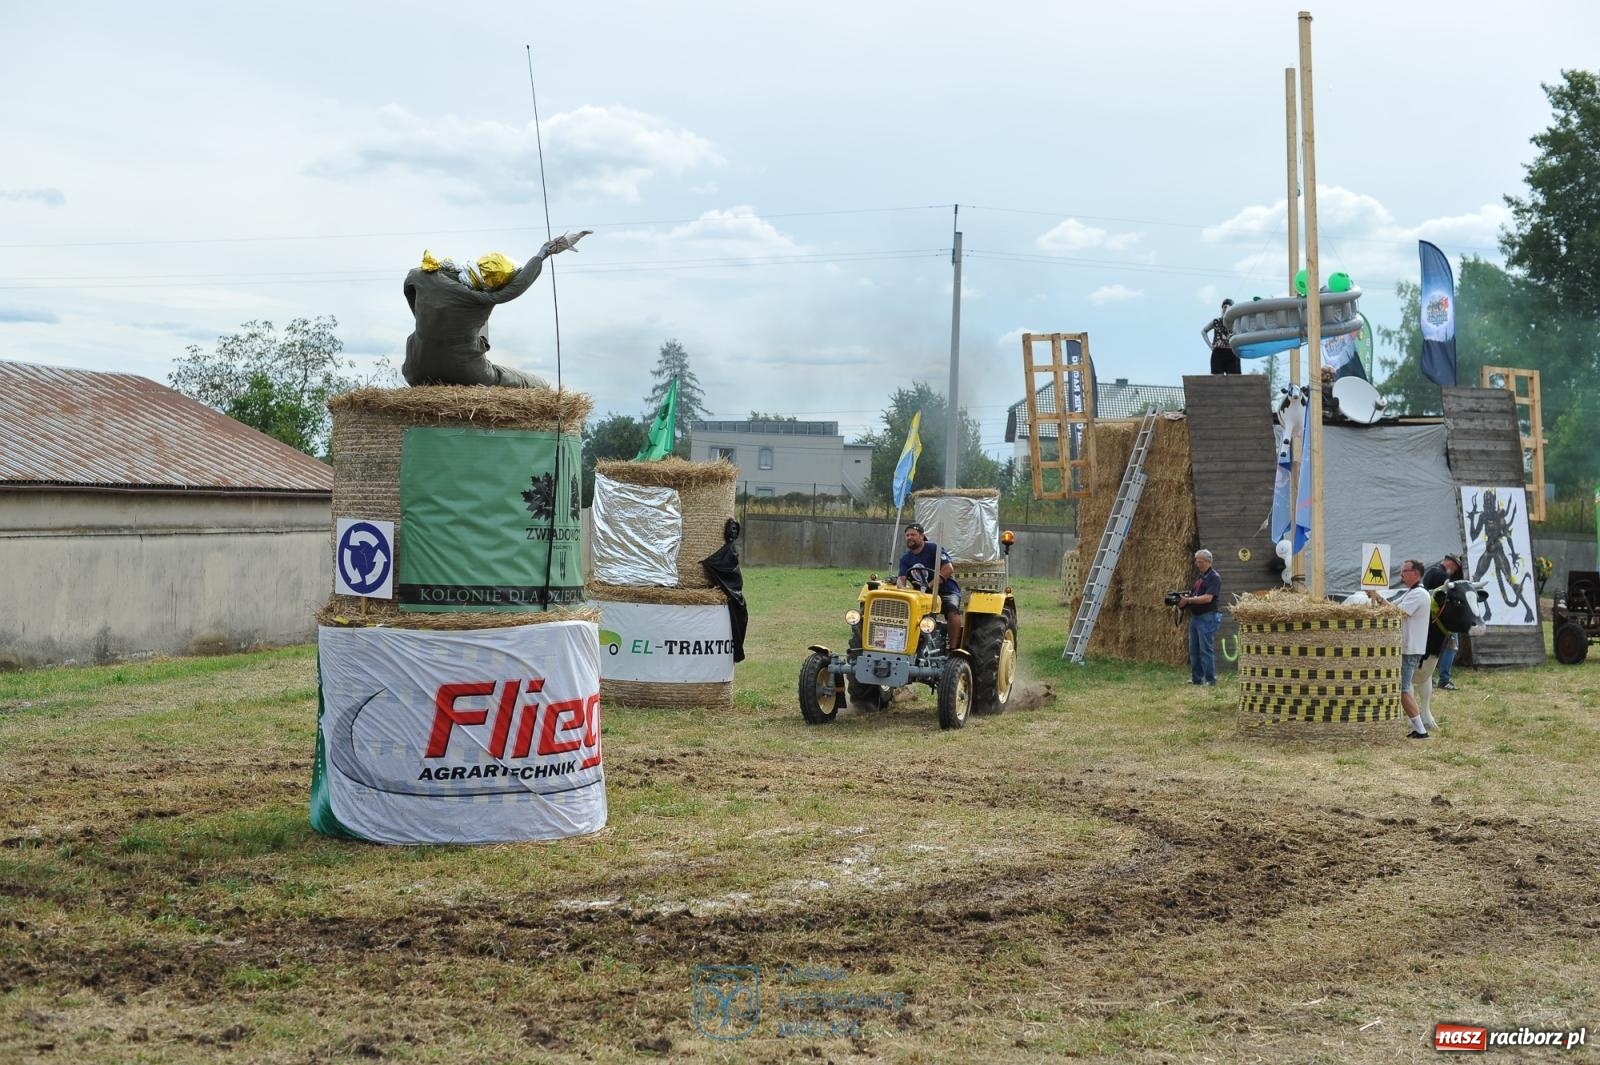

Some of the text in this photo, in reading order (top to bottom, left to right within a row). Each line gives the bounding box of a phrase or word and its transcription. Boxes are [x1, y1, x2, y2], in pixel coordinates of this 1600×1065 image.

[525, 527, 581, 541] ZWIADOWC
[420, 588, 501, 602] KOLONIE
[509, 589, 539, 603] DLA
[418, 760, 577, 781] AGRARTECHNIK
